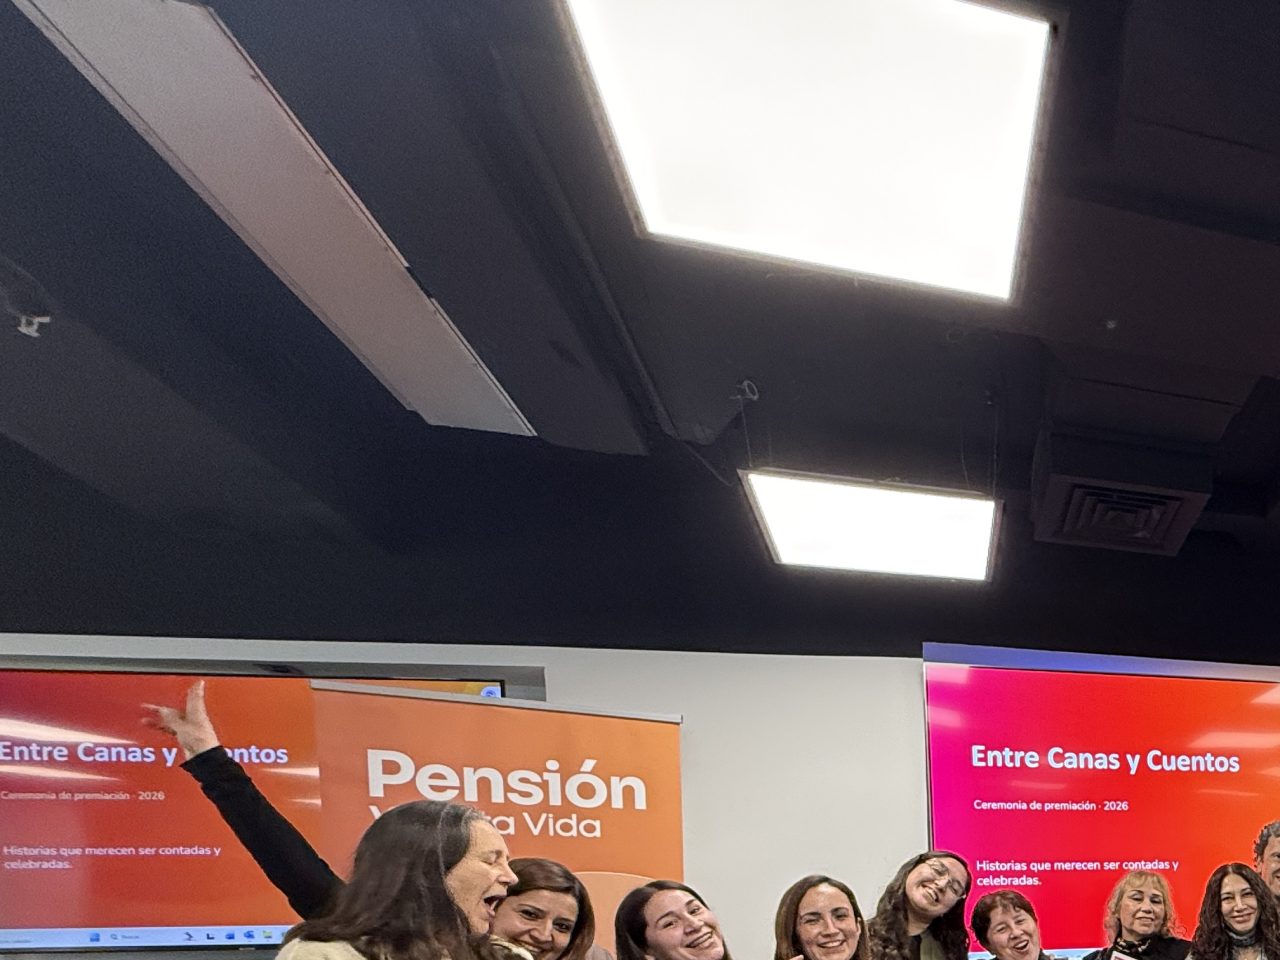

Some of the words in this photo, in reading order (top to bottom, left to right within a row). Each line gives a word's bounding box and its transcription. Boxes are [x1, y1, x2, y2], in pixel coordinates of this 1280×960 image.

[0, 741, 69, 761] Entre
[77, 742, 155, 762] Canas
[161, 747, 178, 767] y
[225, 745, 289, 764] ntos
[971, 744, 1040, 769] Entre
[1047, 746, 1121, 770] Canas
[1126, 753, 1141, 775] y
[1147, 750, 1241, 773] Cuentos
[366, 748, 647, 811] Pensión
[1, 791, 56, 800] Ceremonia
[58, 791, 71, 800] de
[74, 790, 130, 802] premiación
[138, 791, 165, 801] 2026
[973, 800, 1028, 811] Ceremonia
[1029, 800, 1042, 811] de
[1044, 800, 1097, 812] premiación
[1103, 801, 1129, 811] 2026
[522, 812, 602, 838] Vida
[3, 846, 57, 856] Historias
[60, 848, 82, 857] que
[85, 847, 136, 856] merecen
[138, 848, 156, 856] ser
[159, 845, 211, 856] contadas
[213, 847, 221, 857] y
[976, 860, 1027, 871] Historias
[1030, 862, 1051, 874] que
[1053, 861, 1101, 871] merecen
[1103, 861, 1120, 871] ser
[1122, 859, 1170, 870] contadas
[1172, 860, 1179, 871] y
[976, 874, 1042, 886] celebradas.
